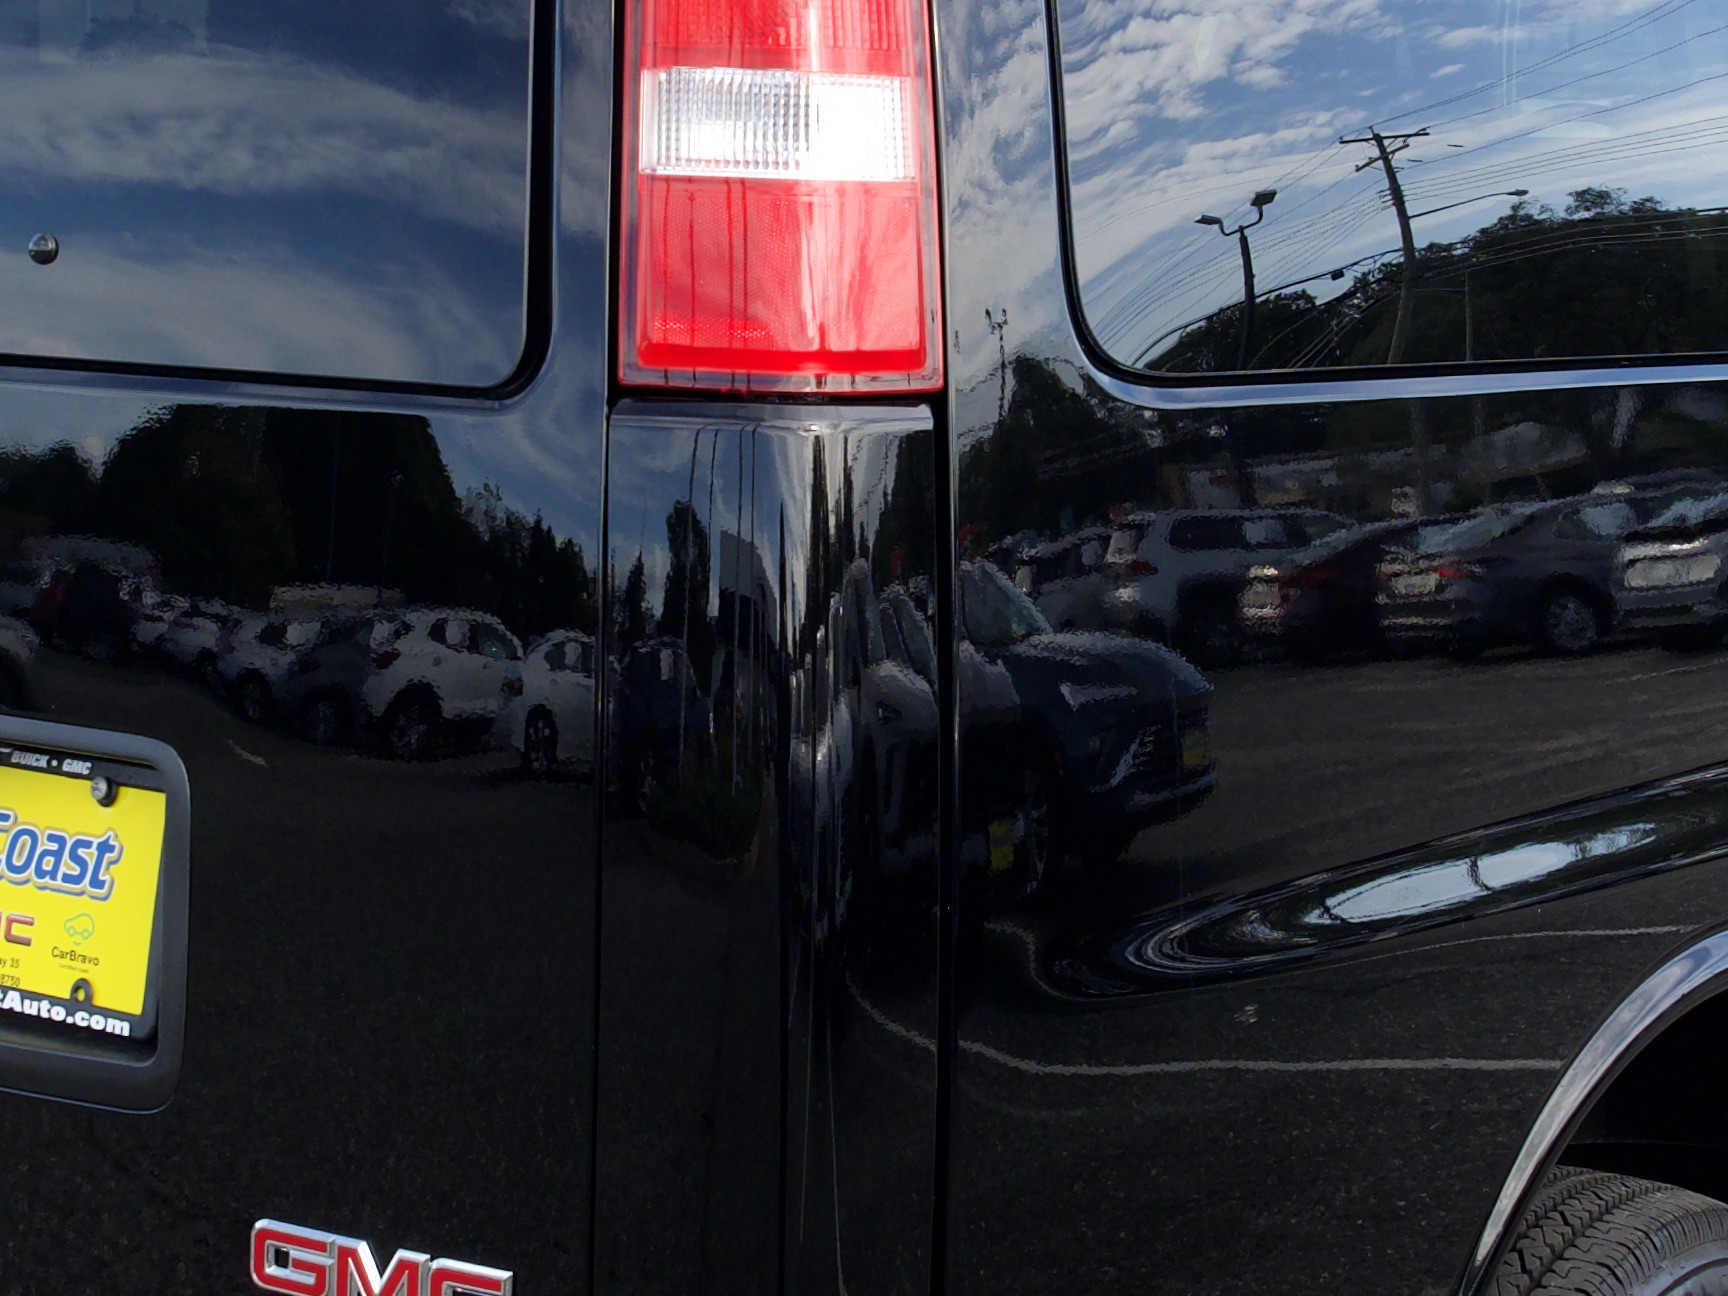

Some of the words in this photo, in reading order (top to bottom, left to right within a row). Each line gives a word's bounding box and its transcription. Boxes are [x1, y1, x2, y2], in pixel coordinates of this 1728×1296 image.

[11, 750, 49, 769] BUICK
[62, 758, 92, 775] GMC
[9, 958, 20, 969] 35
[51, 946, 100, 966] CarBravo
